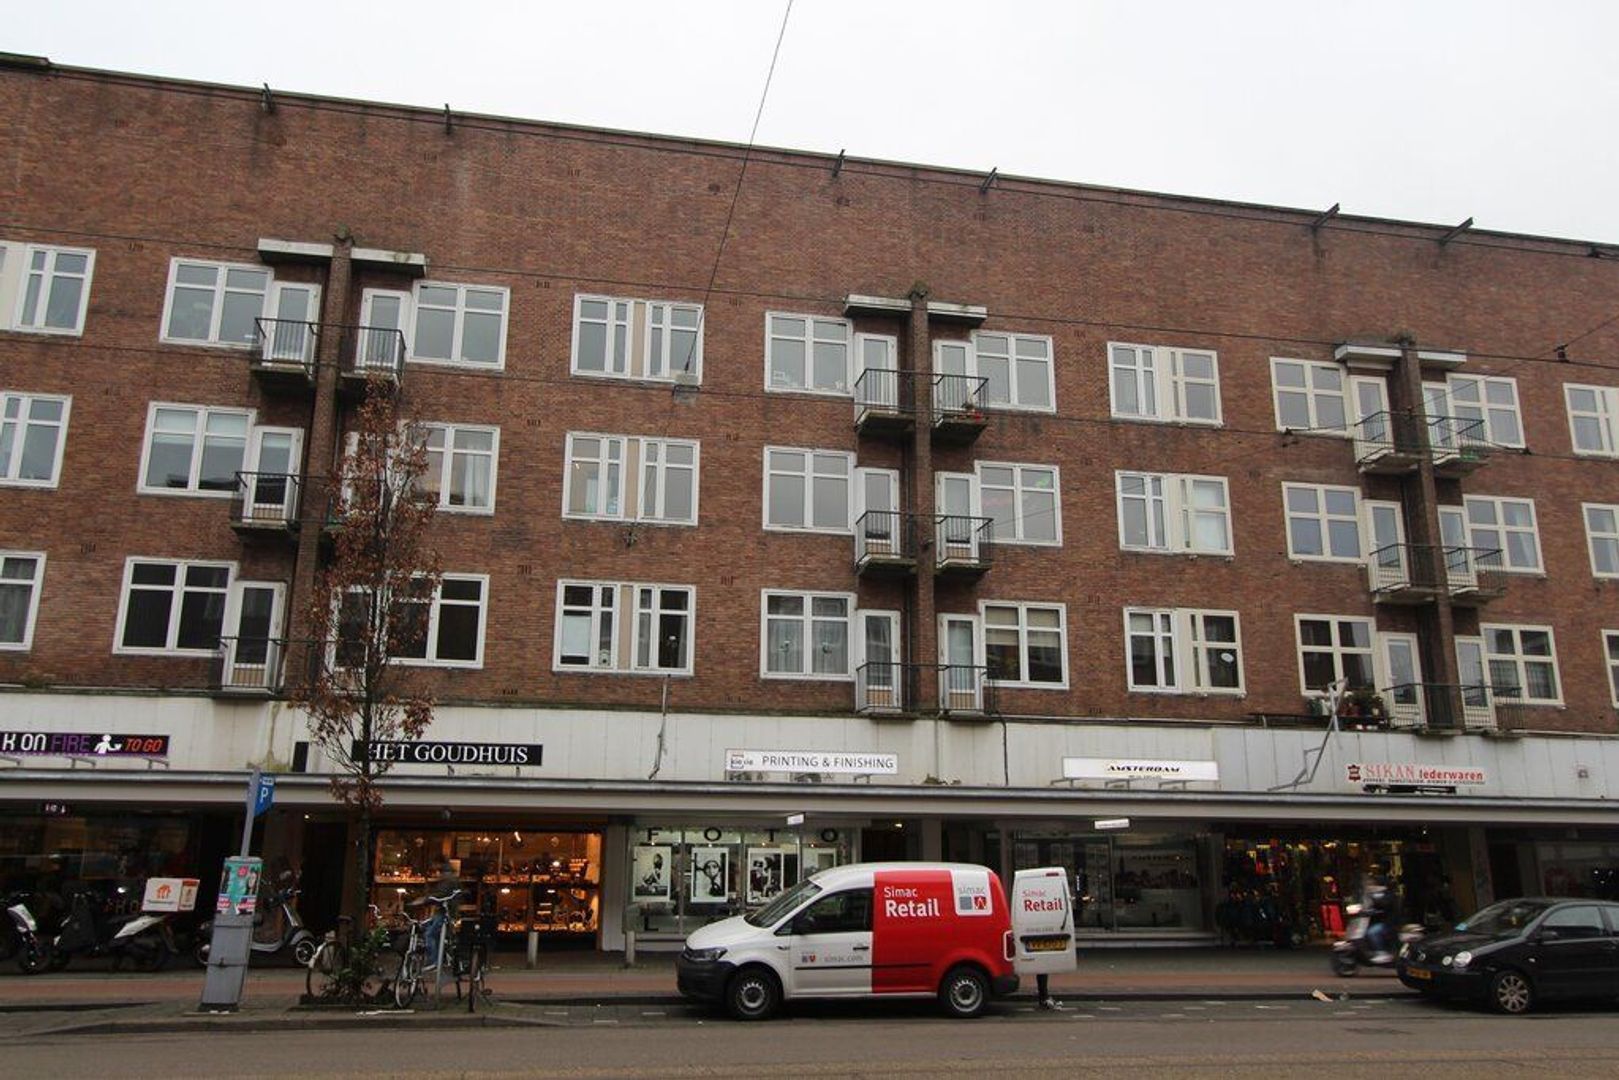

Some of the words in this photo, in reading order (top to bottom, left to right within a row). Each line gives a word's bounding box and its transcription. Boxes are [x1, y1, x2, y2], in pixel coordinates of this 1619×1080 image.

[20, 733, 47, 751] ON
[51, 734, 91, 753] FIRE
[126, 737, 142, 752] TO
[143, 738, 163, 753] GO
[369, 743, 410, 761] HET
[415, 744, 528, 763] GOUDHUIS
[762, 755, 819, 768] PRINTING
[822, 757, 830, 768] &
[834, 757, 894, 769] FINISHING
[1108, 765, 1180, 773] AMSTERDAM
[1365, 764, 1415, 779] SIKAN
[1419, 768, 1484, 780] lederwaren
[260, 786, 269, 803] P
[647, 827, 839, 843] FOTO
[883, 886, 918, 898] Simac
[959, 886, 984, 894] simac
[885, 898, 941, 918] Retail
[1024, 898, 1063, 912] Retail
